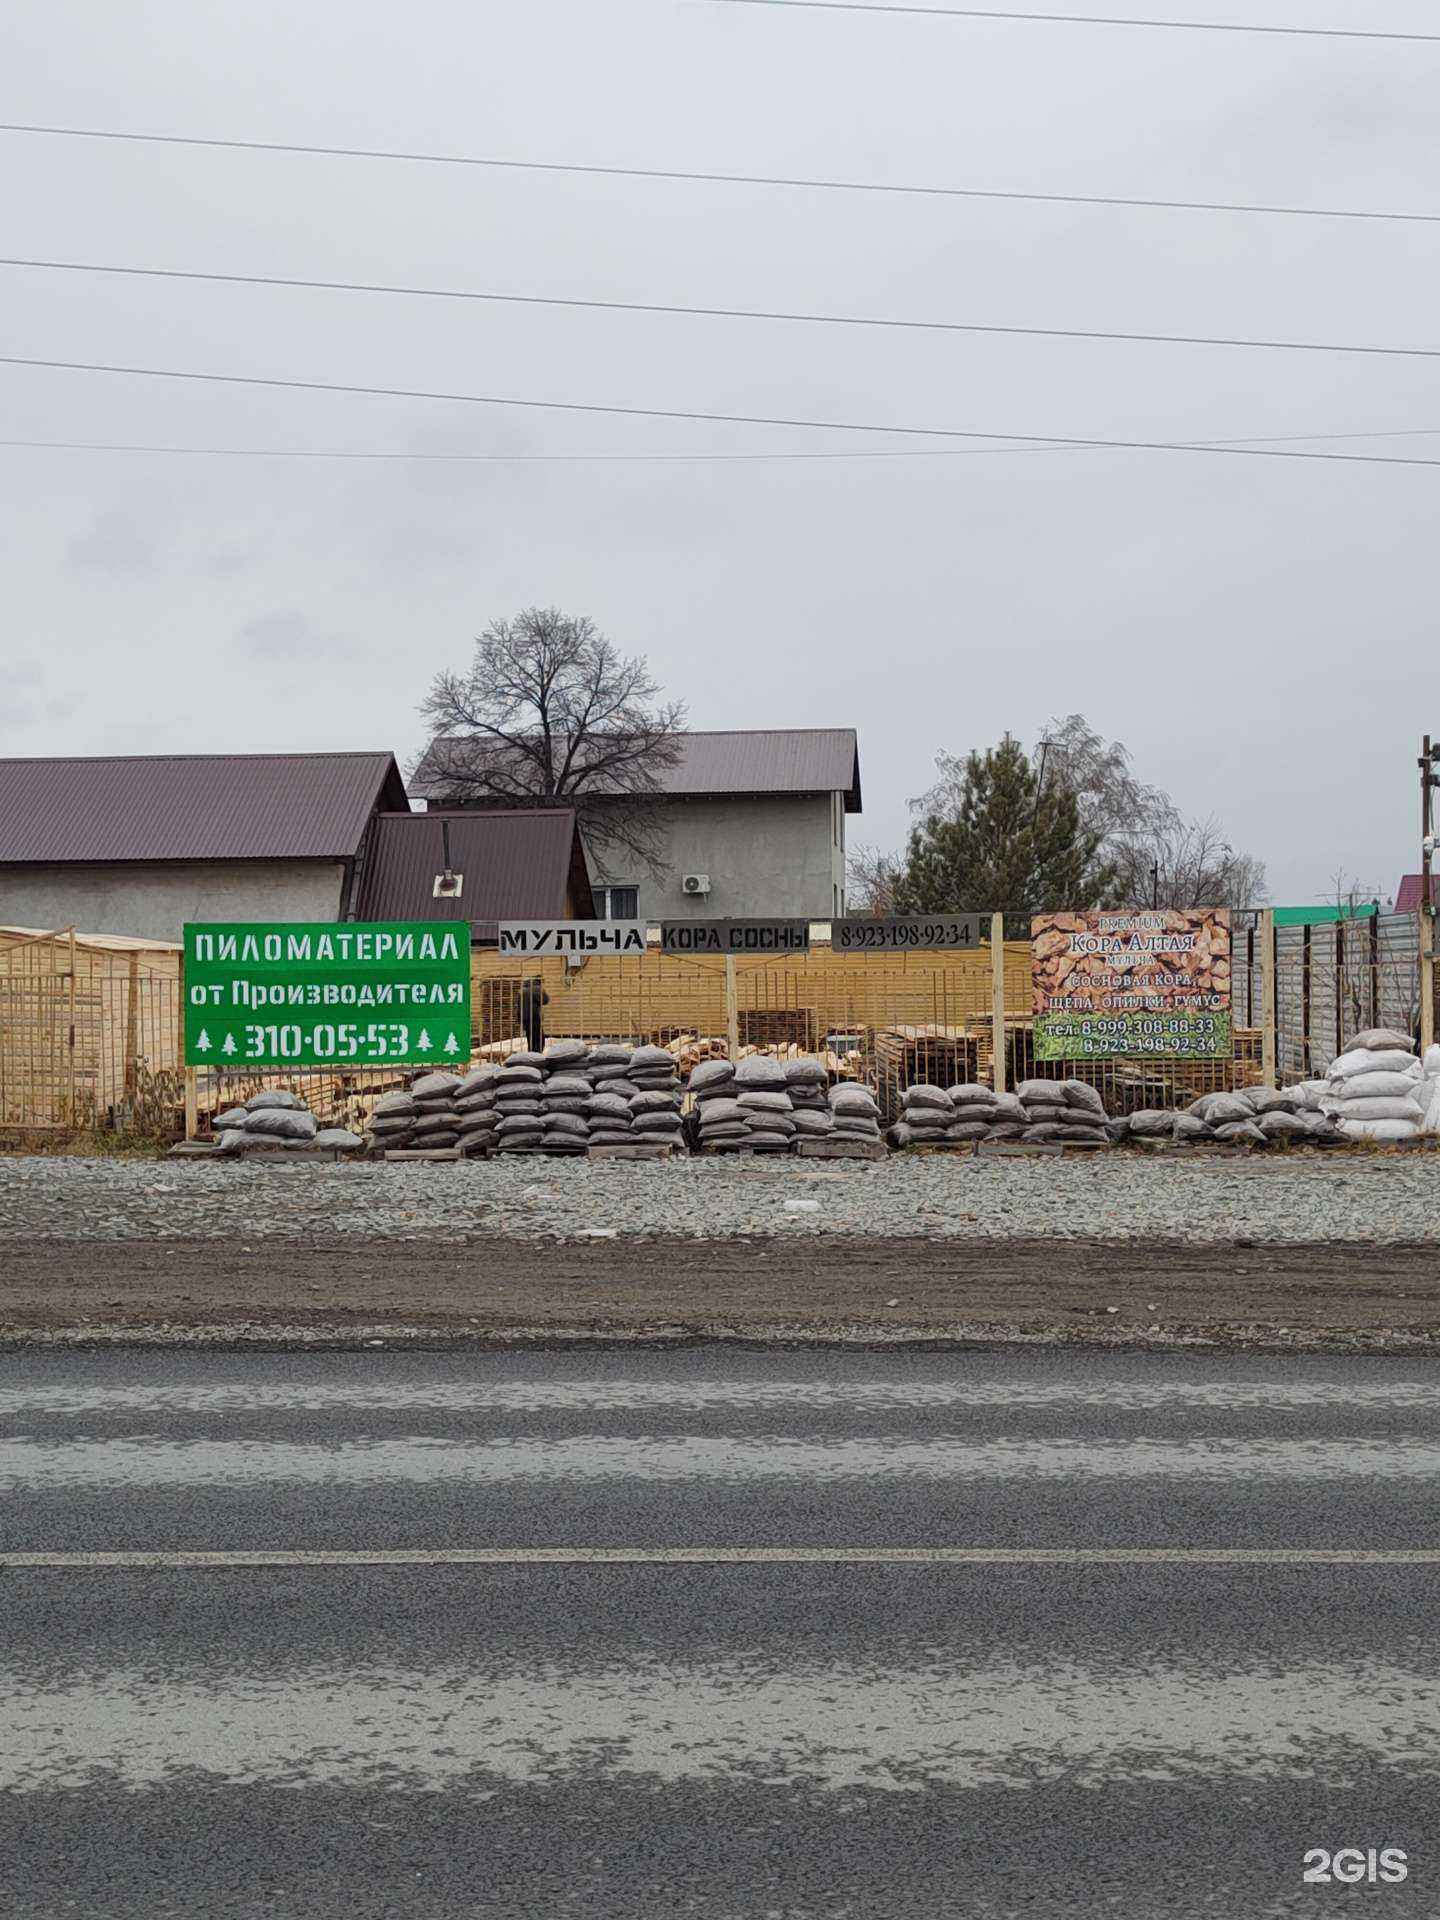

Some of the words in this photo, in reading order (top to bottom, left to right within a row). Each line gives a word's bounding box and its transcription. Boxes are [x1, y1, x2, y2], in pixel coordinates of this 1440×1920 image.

[1099, 916, 1166, 930] PREMIUM
[195, 933, 459, 961] ПИЛОМАТЕРИАЛ
[500, 929, 644, 951] МУЛЬЧА
[662, 927, 722, 949] КОРА
[729, 927, 809, 949] СОСНЫ
[1071, 974, 1150, 987] СОСНОВАЯ
[190, 984, 225, 1005] от
[232, 980, 464, 1010] Производителя
[1174, 994, 1221, 1007] ГУМУС
